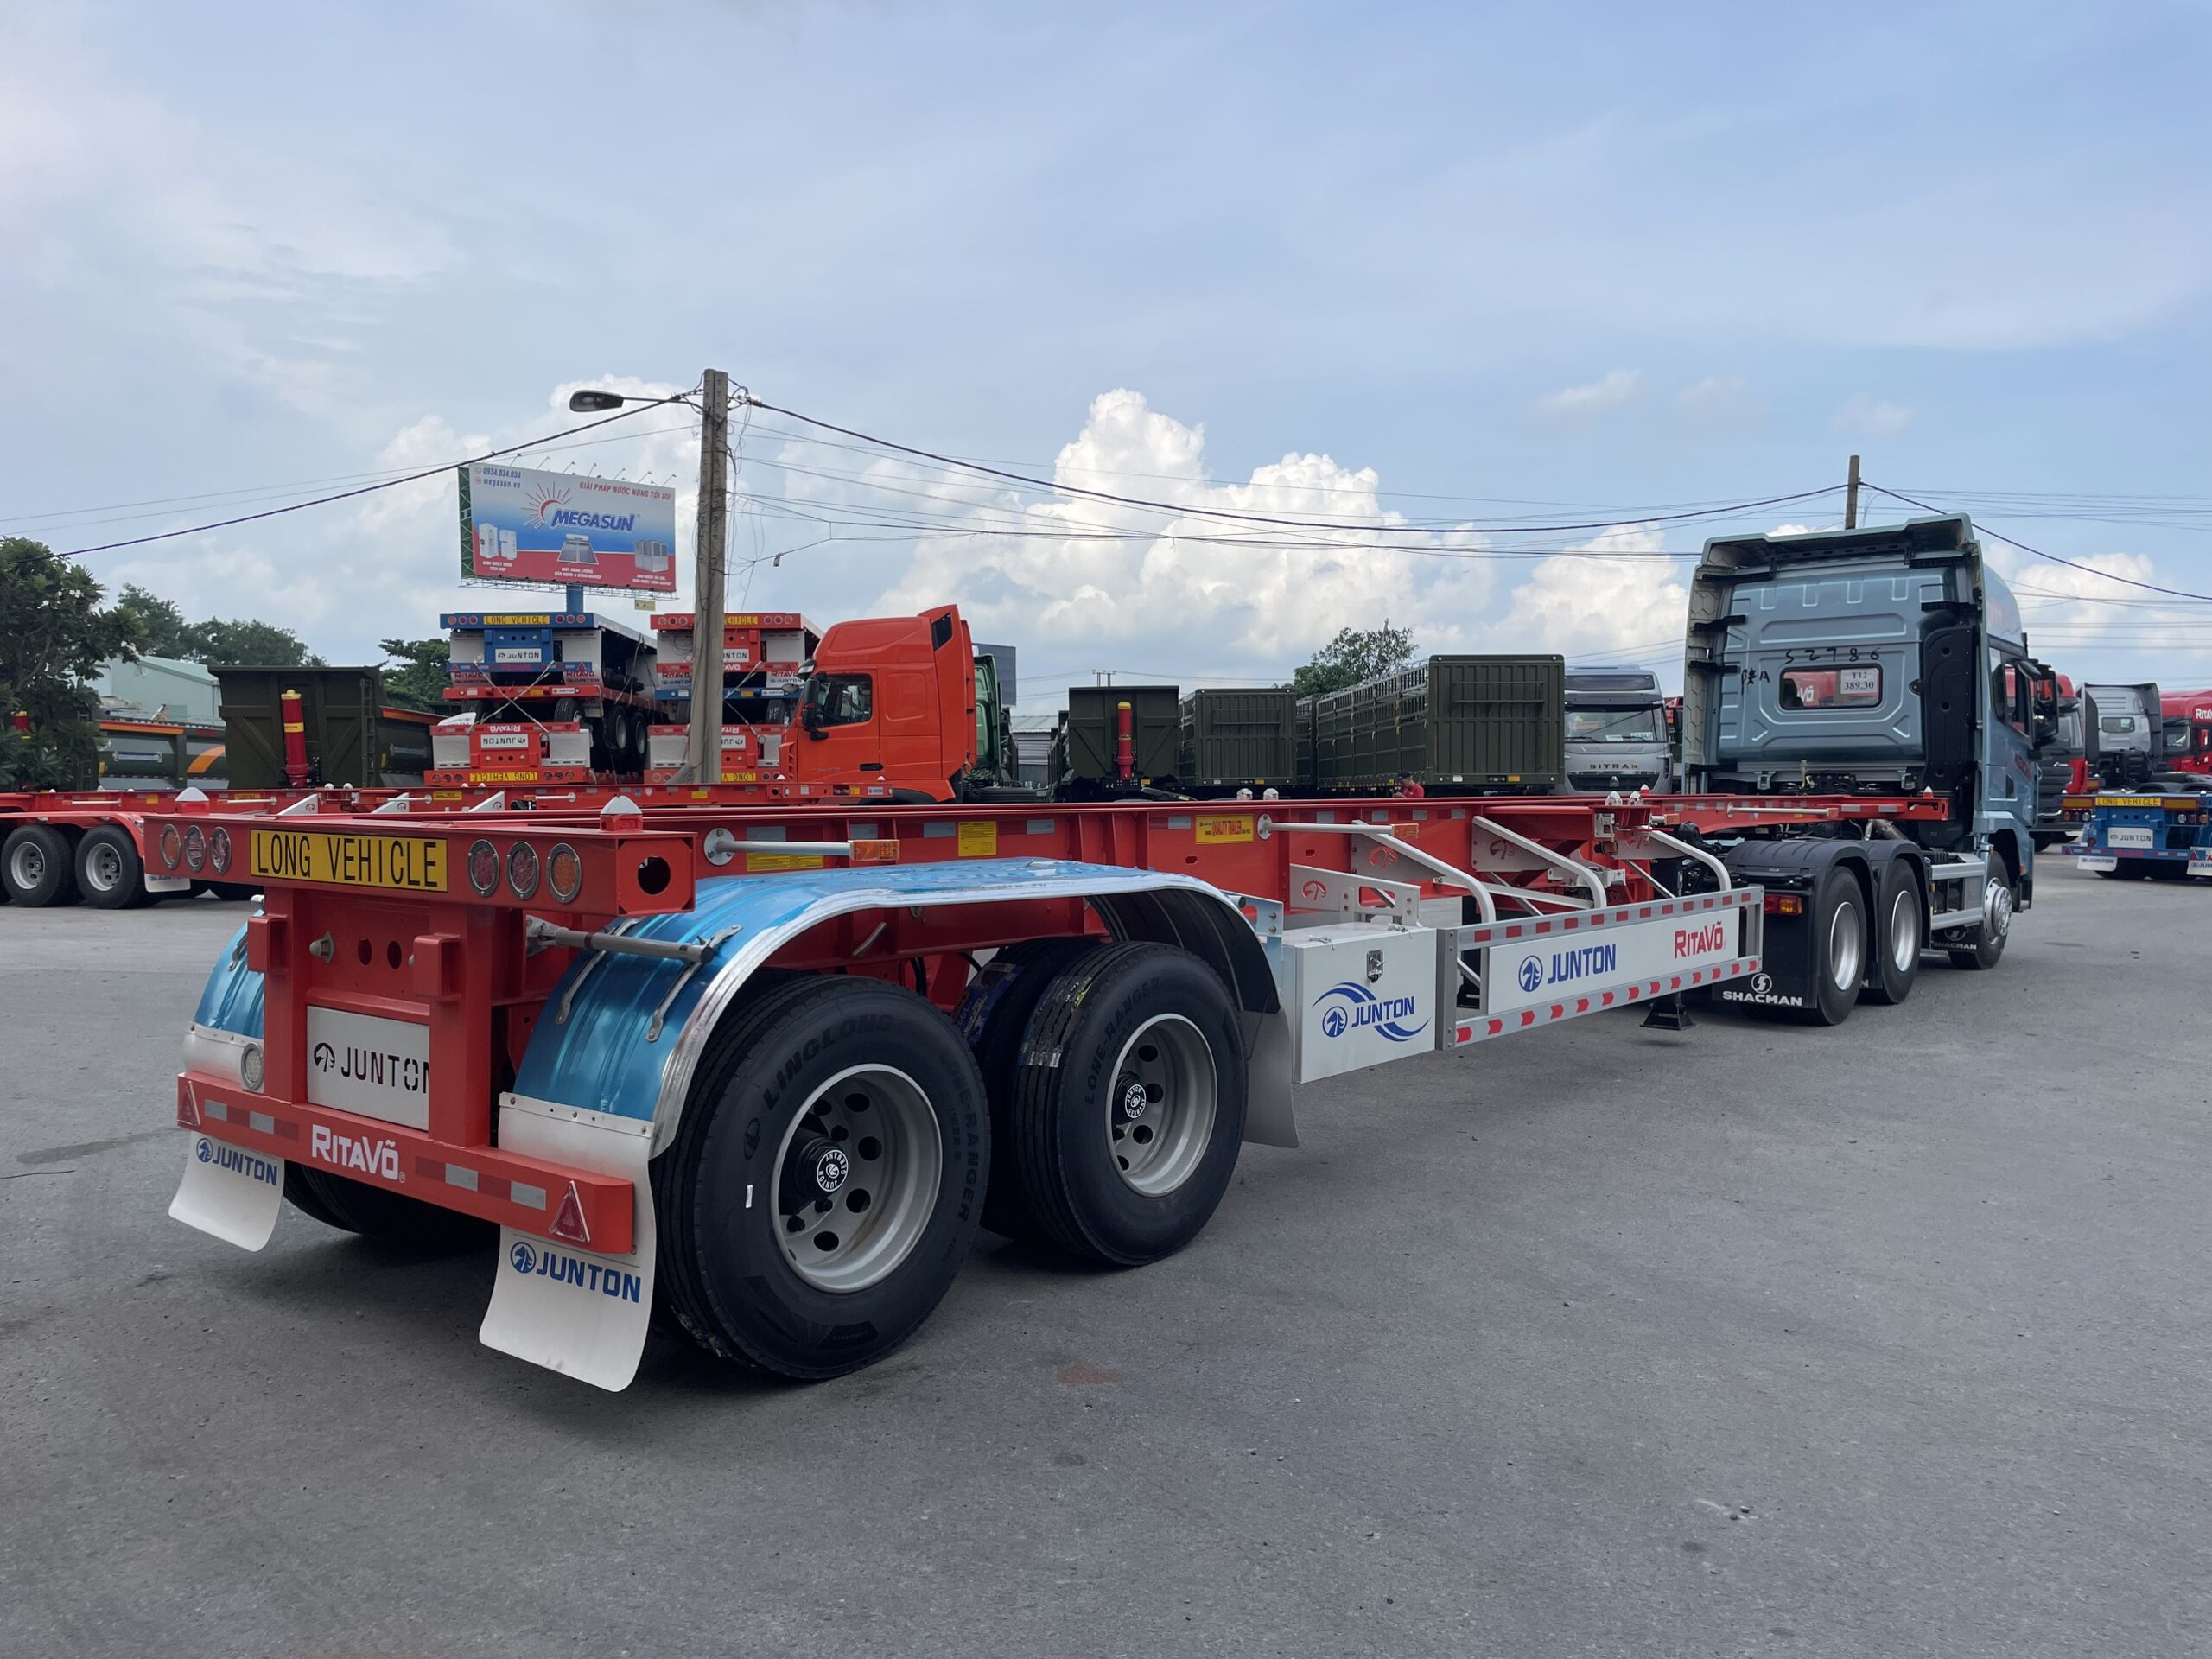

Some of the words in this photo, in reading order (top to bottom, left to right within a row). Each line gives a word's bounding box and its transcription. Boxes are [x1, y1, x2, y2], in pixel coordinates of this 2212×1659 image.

[483, 467, 521, 479] 0934.034.034
[483, 478, 521, 488] megasun.vn
[550, 509, 635, 531] MEGASUN
[486, 616, 506, 625] LONG
[512, 615, 548, 625] VEHICLE
[1844, 682, 1874, 690] 389.30
[474, 772, 509, 782] VEHICLE
[514, 772, 538, 781] LONG
[734, 772, 755, 781] LONG
[2097, 798, 2118, 806] LONG
[2122, 798, 2159, 806] VEHICLE
[257, 834, 311, 878] LONG
[328, 836, 438, 888] VEHICLE
[1547, 944, 1618, 985] JUNTON
[1722, 990, 1802, 1007] SHACMAN
[1351, 995, 1415, 1029] JUNTON
[763, 1014, 893, 1111] LINGLONG
[1127, 1086, 1142, 1103] JUNTON
[212, 1145, 278, 1186] JUNTON
[825, 1152, 847, 1175] GERMANY
[818, 1170, 838, 1189] JUNTON
[536, 1249, 641, 1304] JUNTON
